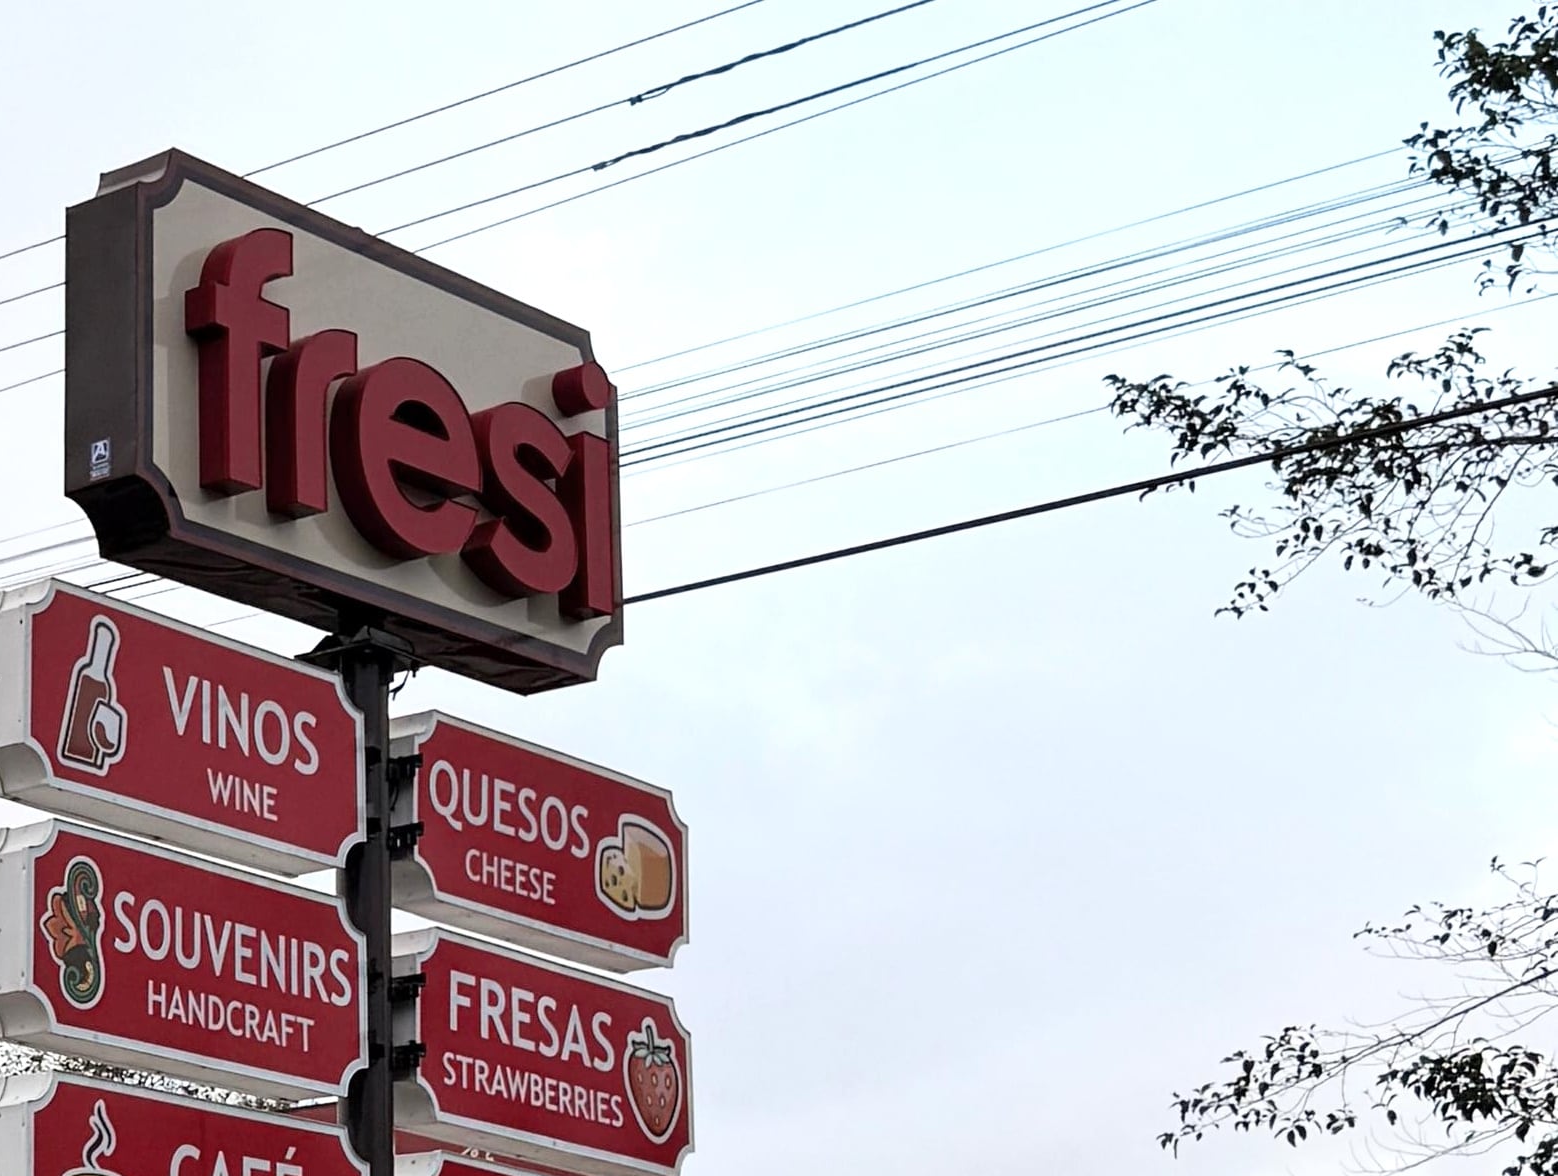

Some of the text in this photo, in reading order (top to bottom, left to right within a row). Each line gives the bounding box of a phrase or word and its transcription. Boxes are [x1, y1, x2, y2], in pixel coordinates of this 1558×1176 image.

[184, 228, 614, 618] fresi
[162, 666, 319, 775] VINOS
[206, 767, 278, 822] WINE
[429, 759, 590, 859] QUESOS
[465, 848, 556, 905] CHEESE
[113, 891, 352, 1007] SOUVENIRS
[148, 979, 315, 1052] HANDCRAFT
[449, 969, 615, 1072] FRESAS
[442, 1051, 624, 1127] STRAWBERRIES
